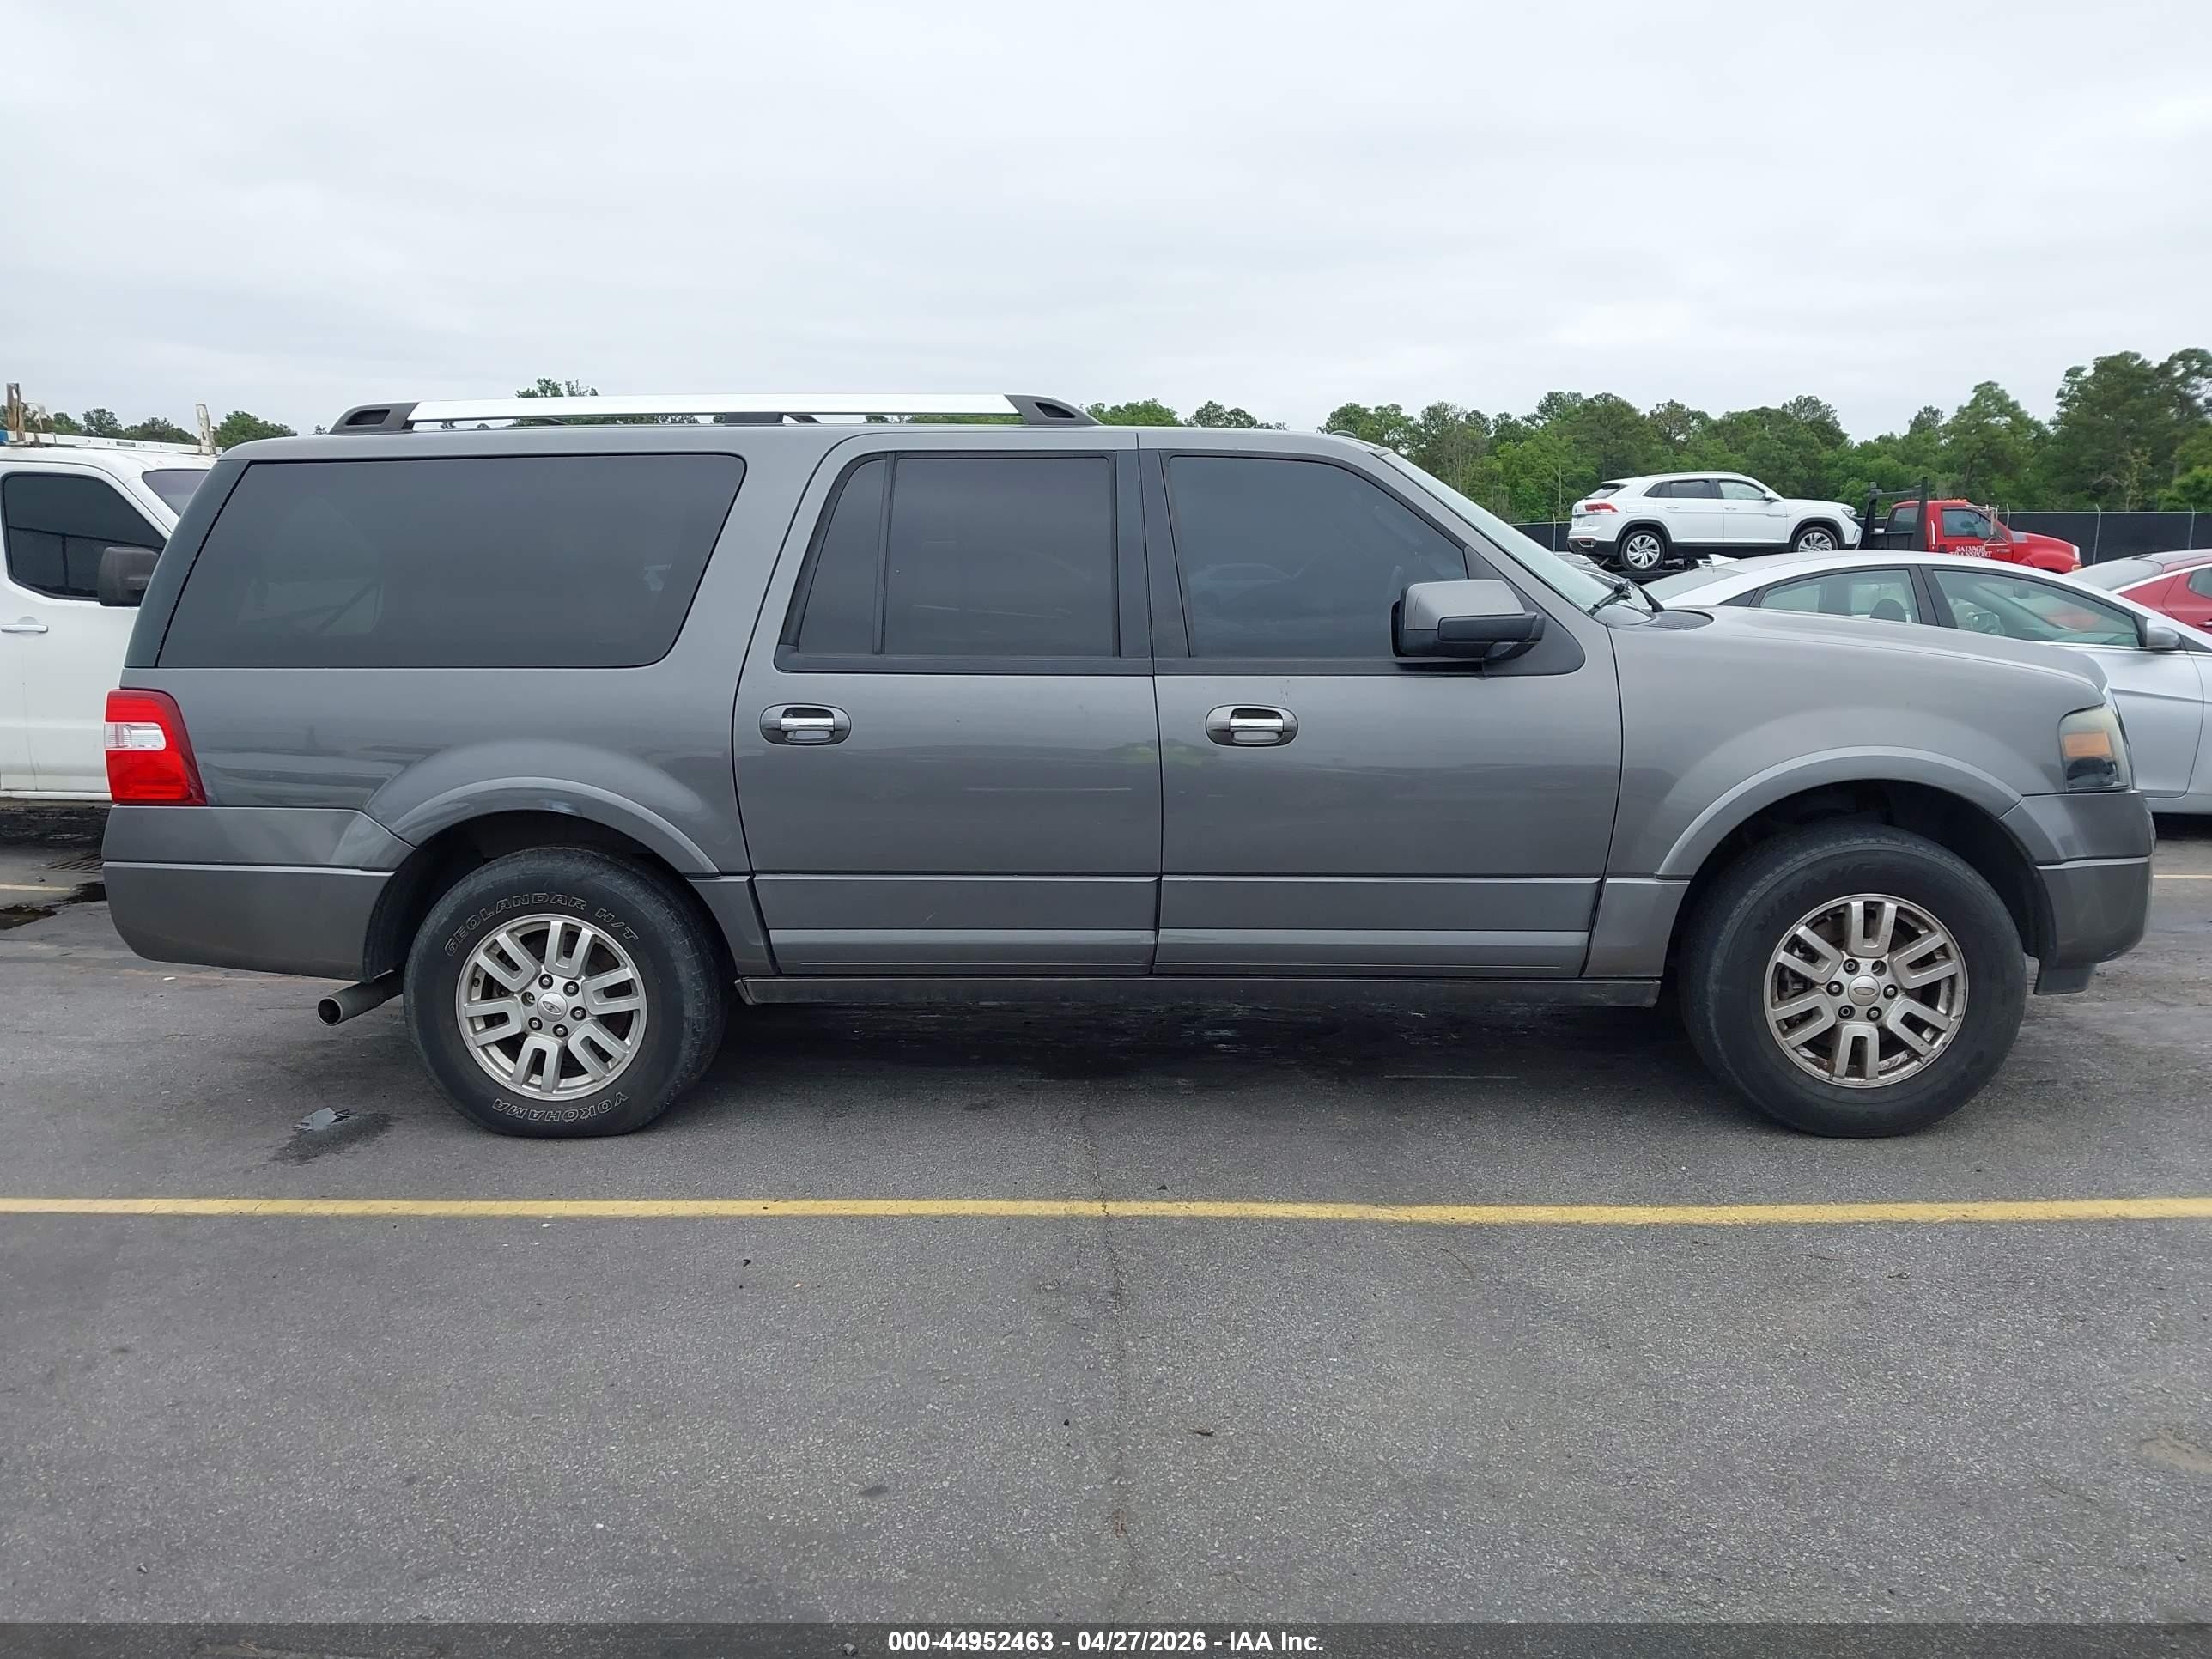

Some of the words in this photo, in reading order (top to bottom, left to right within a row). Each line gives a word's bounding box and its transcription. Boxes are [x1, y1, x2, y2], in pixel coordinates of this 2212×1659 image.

[444, 892, 587, 956] GEOLANDAR
[594, 908, 639, 940] H/T
[492, 1091, 629, 1122] YOKOHAMA
